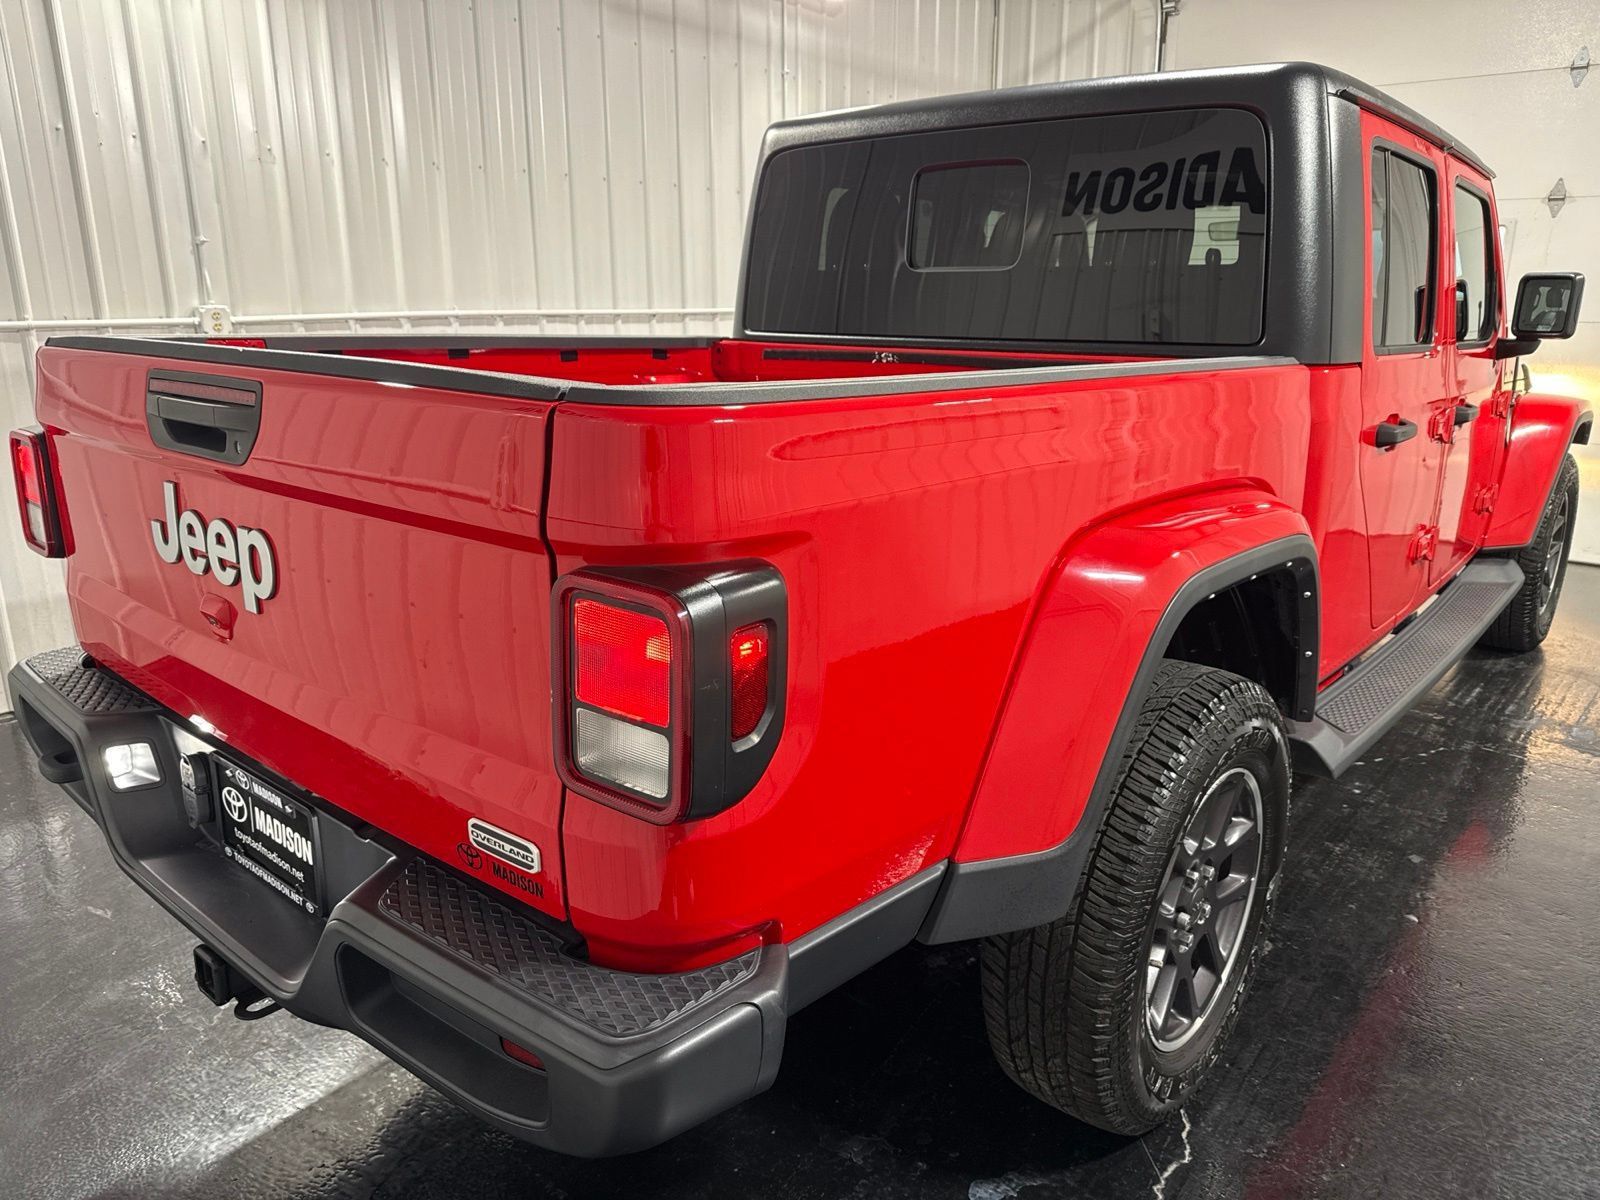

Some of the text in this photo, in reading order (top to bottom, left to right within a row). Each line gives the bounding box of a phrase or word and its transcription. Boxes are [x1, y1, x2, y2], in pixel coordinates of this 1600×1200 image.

[151, 480, 277, 614] Jeep
[252, 782, 283, 808] MADISON
[255, 806, 313, 865] MADISON
[471, 830, 534, 863] OVERLAND
[234, 851, 303, 906] TOYOTAOFMADISON.NET
[493, 862, 544, 898] MADISON
